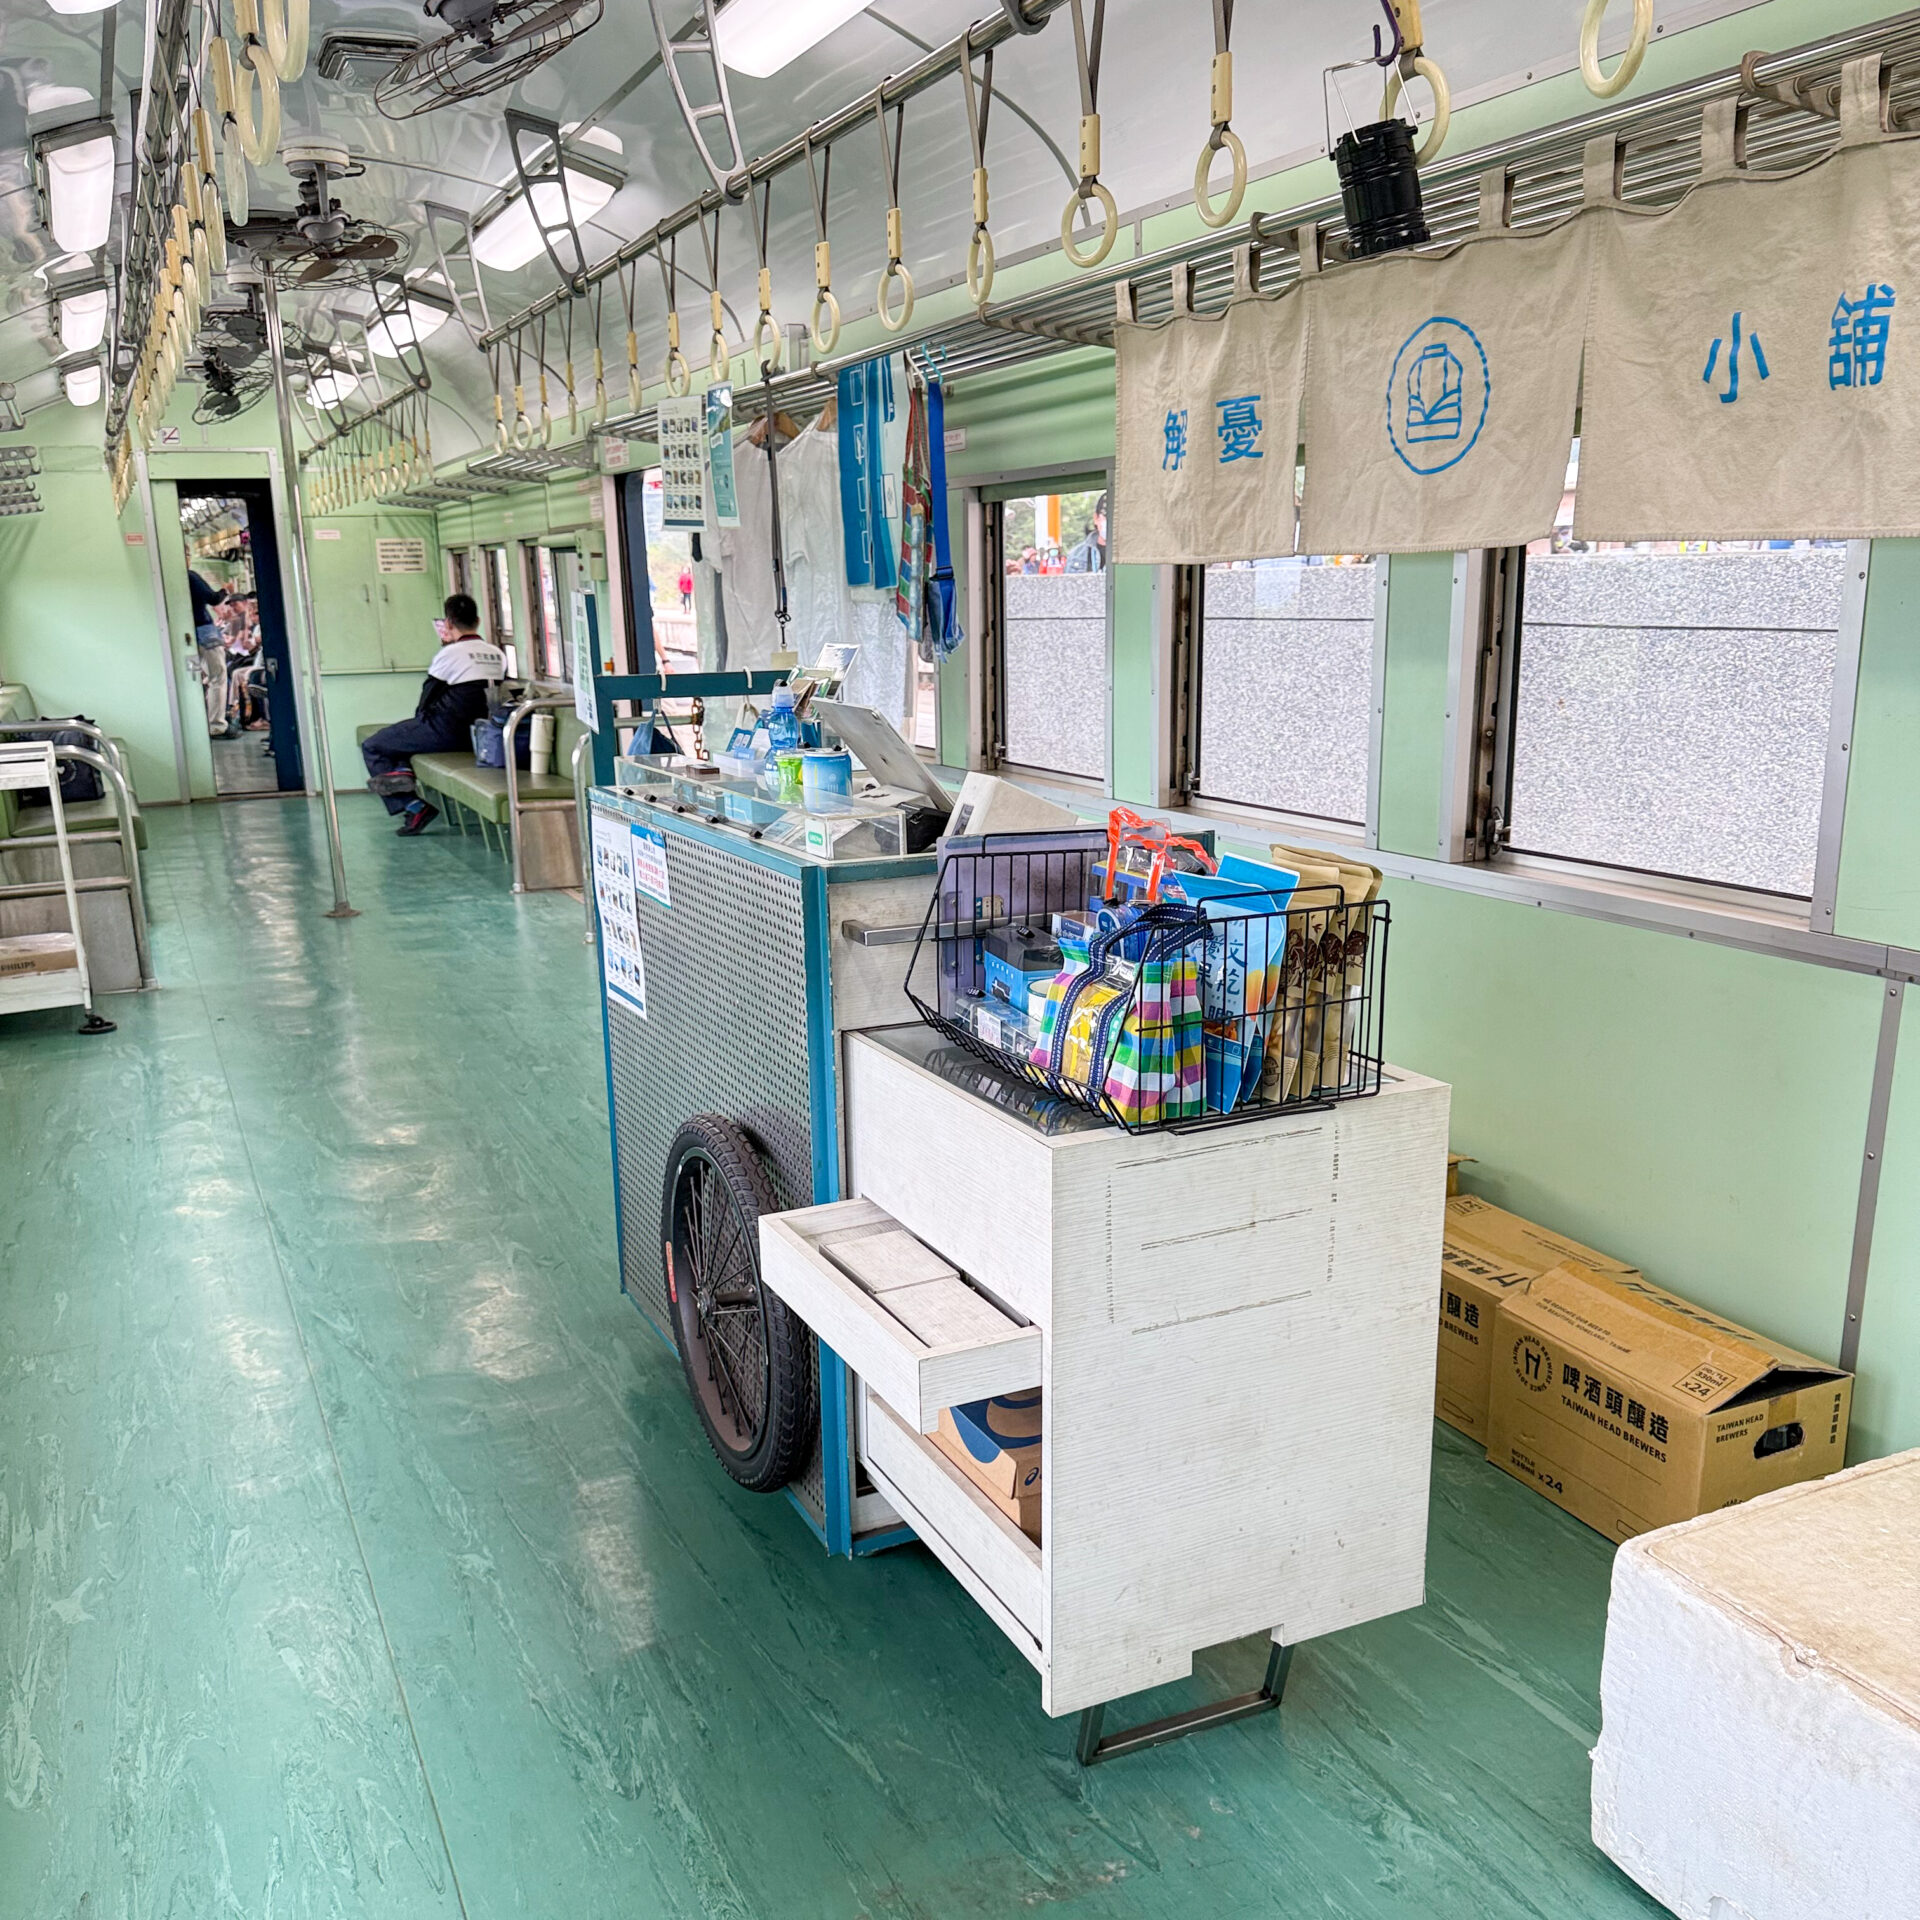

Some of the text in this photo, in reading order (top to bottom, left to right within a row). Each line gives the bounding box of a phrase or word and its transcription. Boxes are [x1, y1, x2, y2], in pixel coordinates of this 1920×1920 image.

[0, 961, 36, 972] PHILIPS
[1444, 1320, 1479, 1346] BREWERS
[1682, 1381, 1710, 1397] x24
[1561, 1395, 1667, 1463] TAIWAN HEAD BREWERS
[1717, 1413, 1764, 1432] TAIWAN HEAD
[1716, 1428, 1748, 1443] BREWERS
[1538, 1471, 1563, 1494] x24
